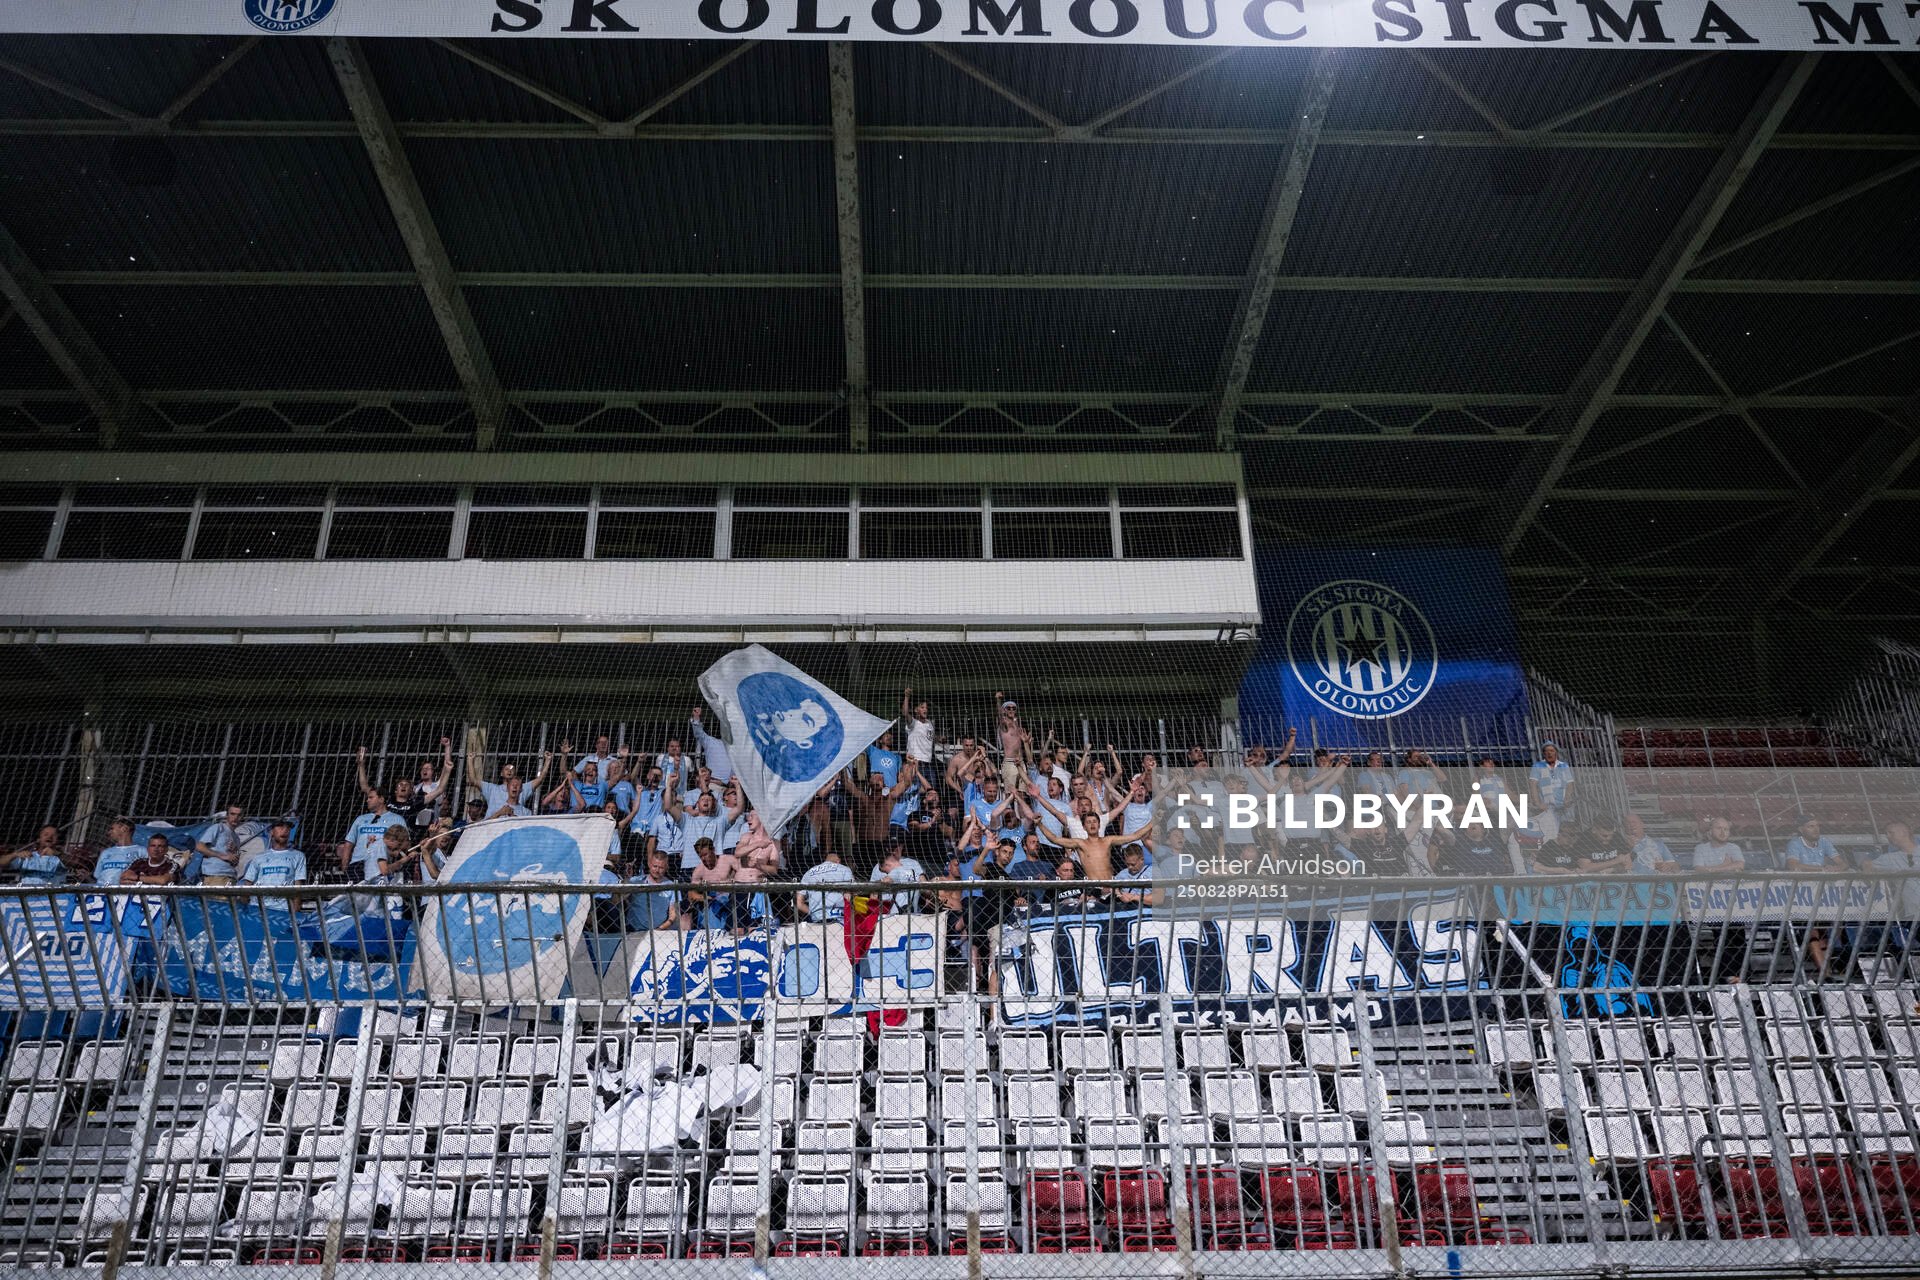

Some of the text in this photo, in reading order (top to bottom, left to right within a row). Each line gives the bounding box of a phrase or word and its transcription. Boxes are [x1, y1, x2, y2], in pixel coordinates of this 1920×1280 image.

[253, 13, 321, 31] OLOMOUC
[490, 0, 1920, 45] SK OLOMOUC SIGMA M
[1306, 586, 1404, 617] SK SIGMA
[1314, 677, 1423, 713] OLOMOUC
[1001, 899, 1483, 1018] ULTRAS
